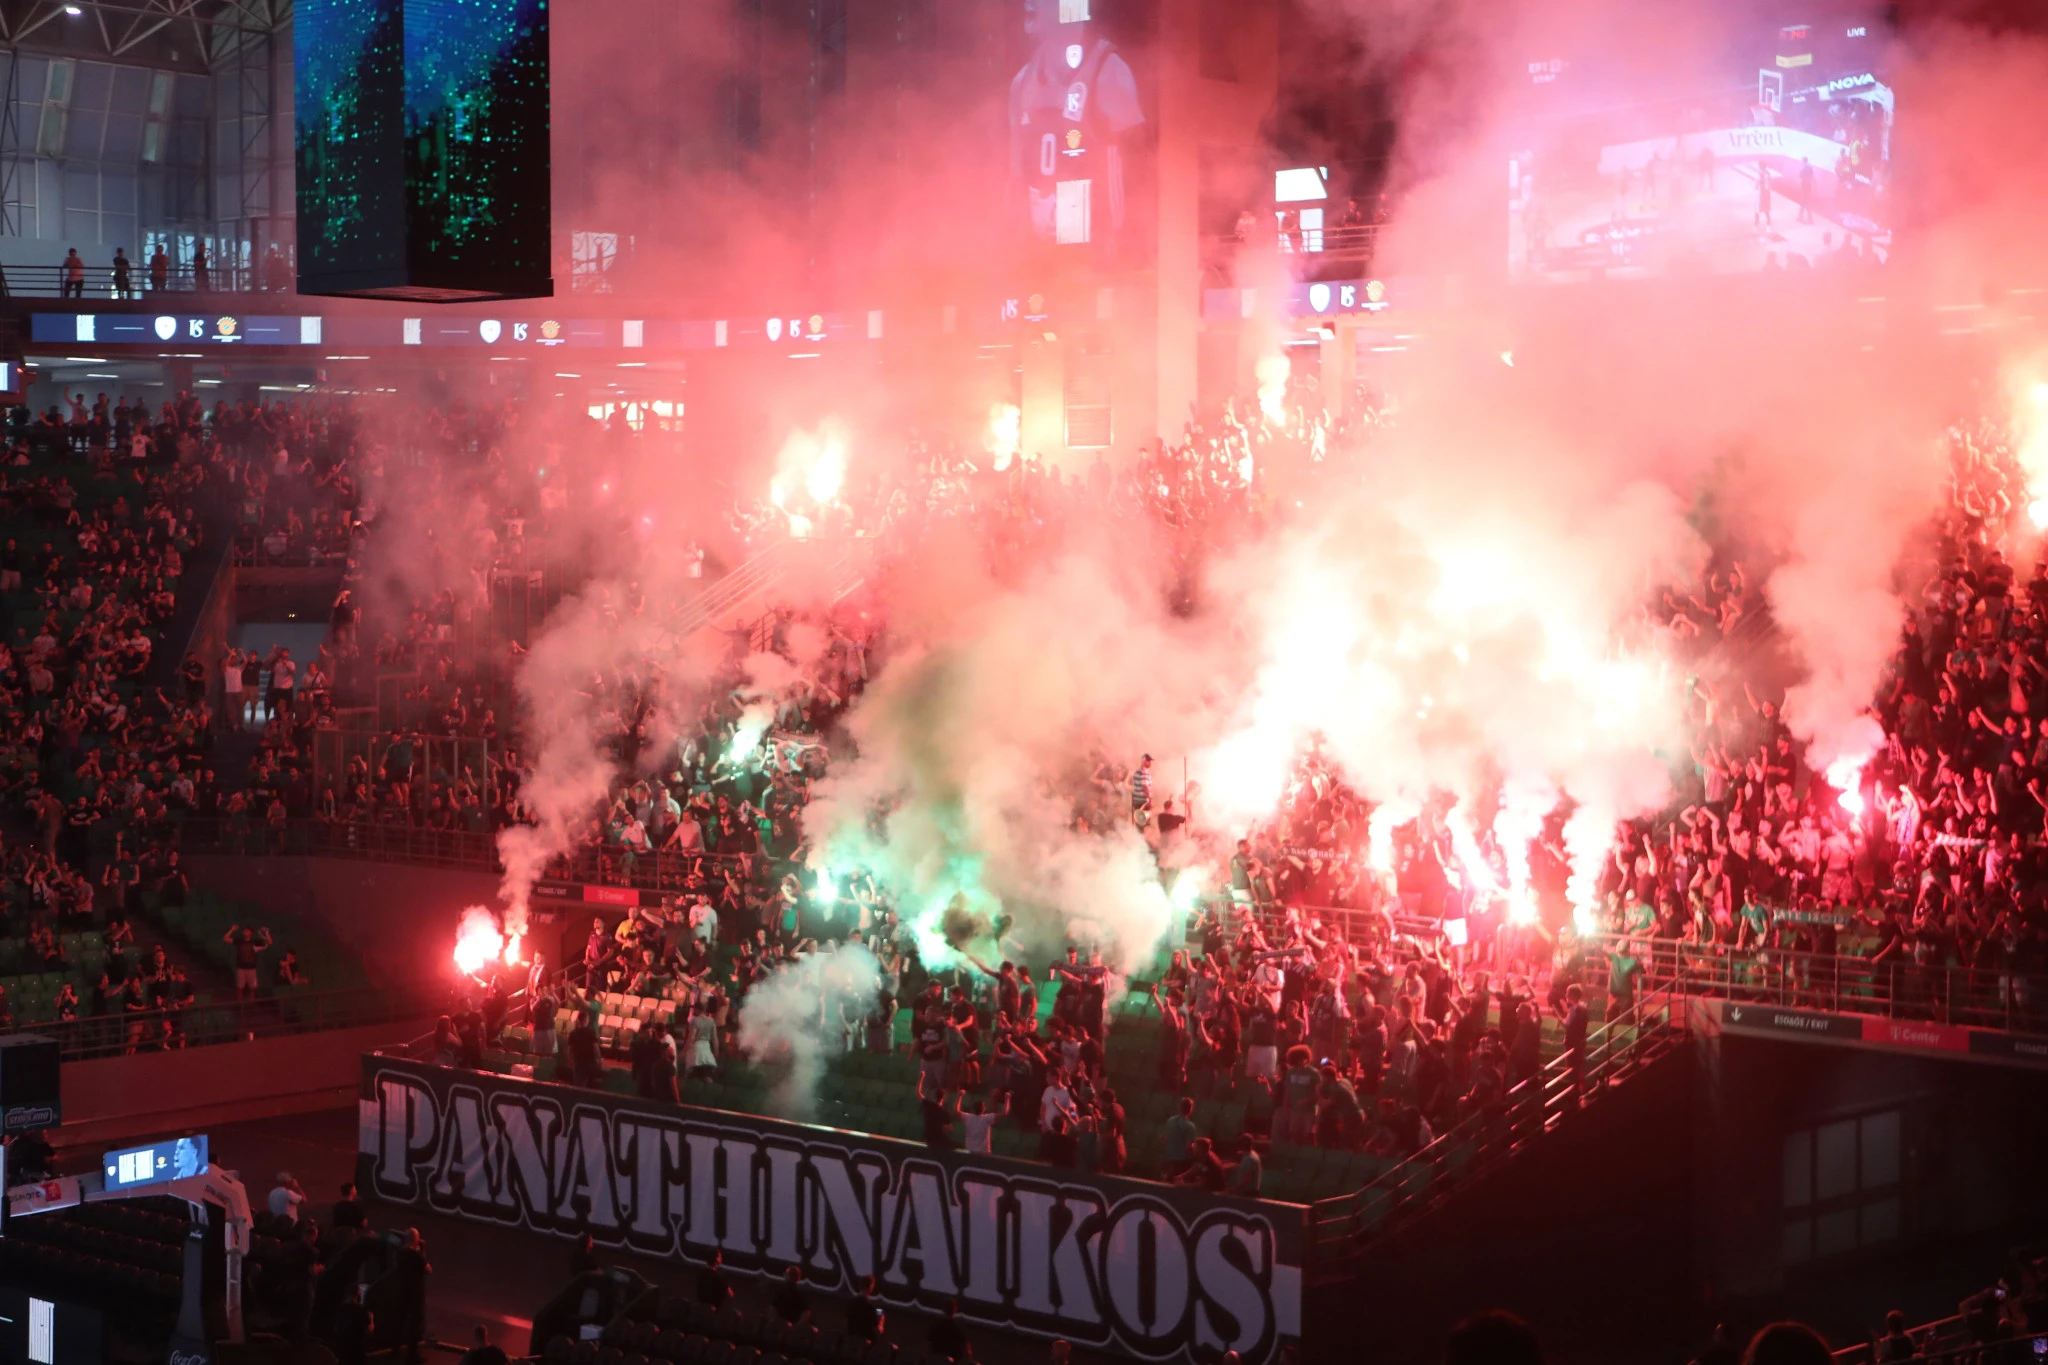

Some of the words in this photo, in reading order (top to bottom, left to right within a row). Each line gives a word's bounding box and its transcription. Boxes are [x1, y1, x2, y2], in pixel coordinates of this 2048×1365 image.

[1847, 27, 1866, 38] LIVE
[1829, 73, 1876, 92] NOVA
[1811, 1019, 1829, 1031] EXIT
[1902, 1029, 1941, 1045] Center
[378, 1080, 1267, 1353] PANATHINAIKOS
